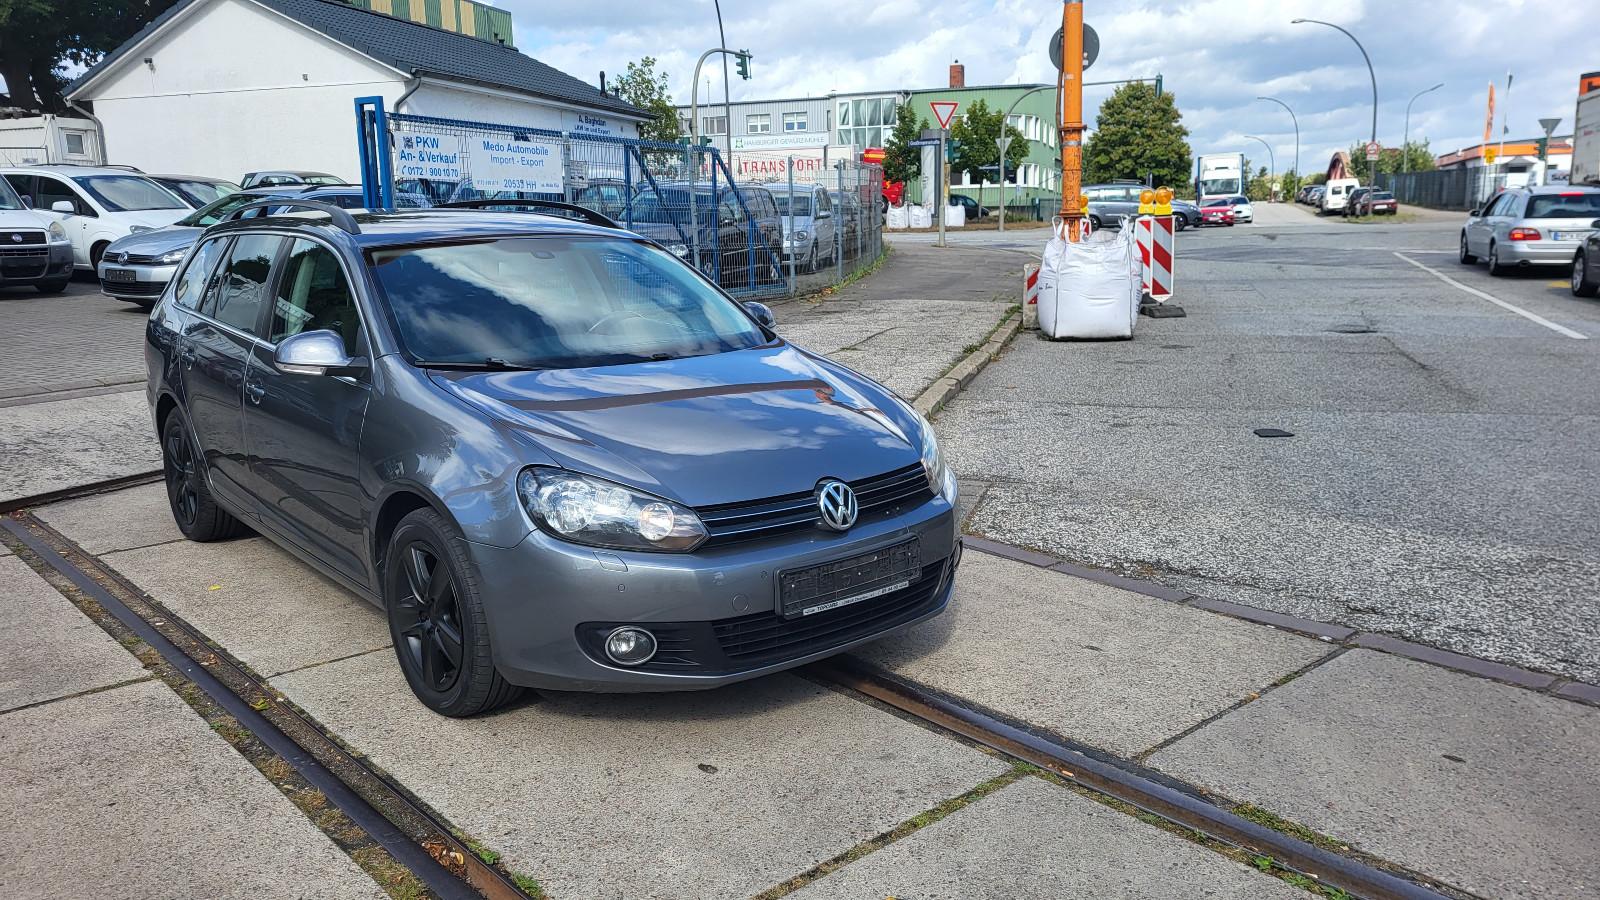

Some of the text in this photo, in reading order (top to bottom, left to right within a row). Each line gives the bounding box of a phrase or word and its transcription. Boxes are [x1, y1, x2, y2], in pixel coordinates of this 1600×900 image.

[415, 136, 439, 149] PKW
[482, 140, 549, 156] Medo Automobile
[400, 149, 457, 164] An- & Verkauf
[490, 153, 515, 166] Import
[520, 156, 544, 167] Export
